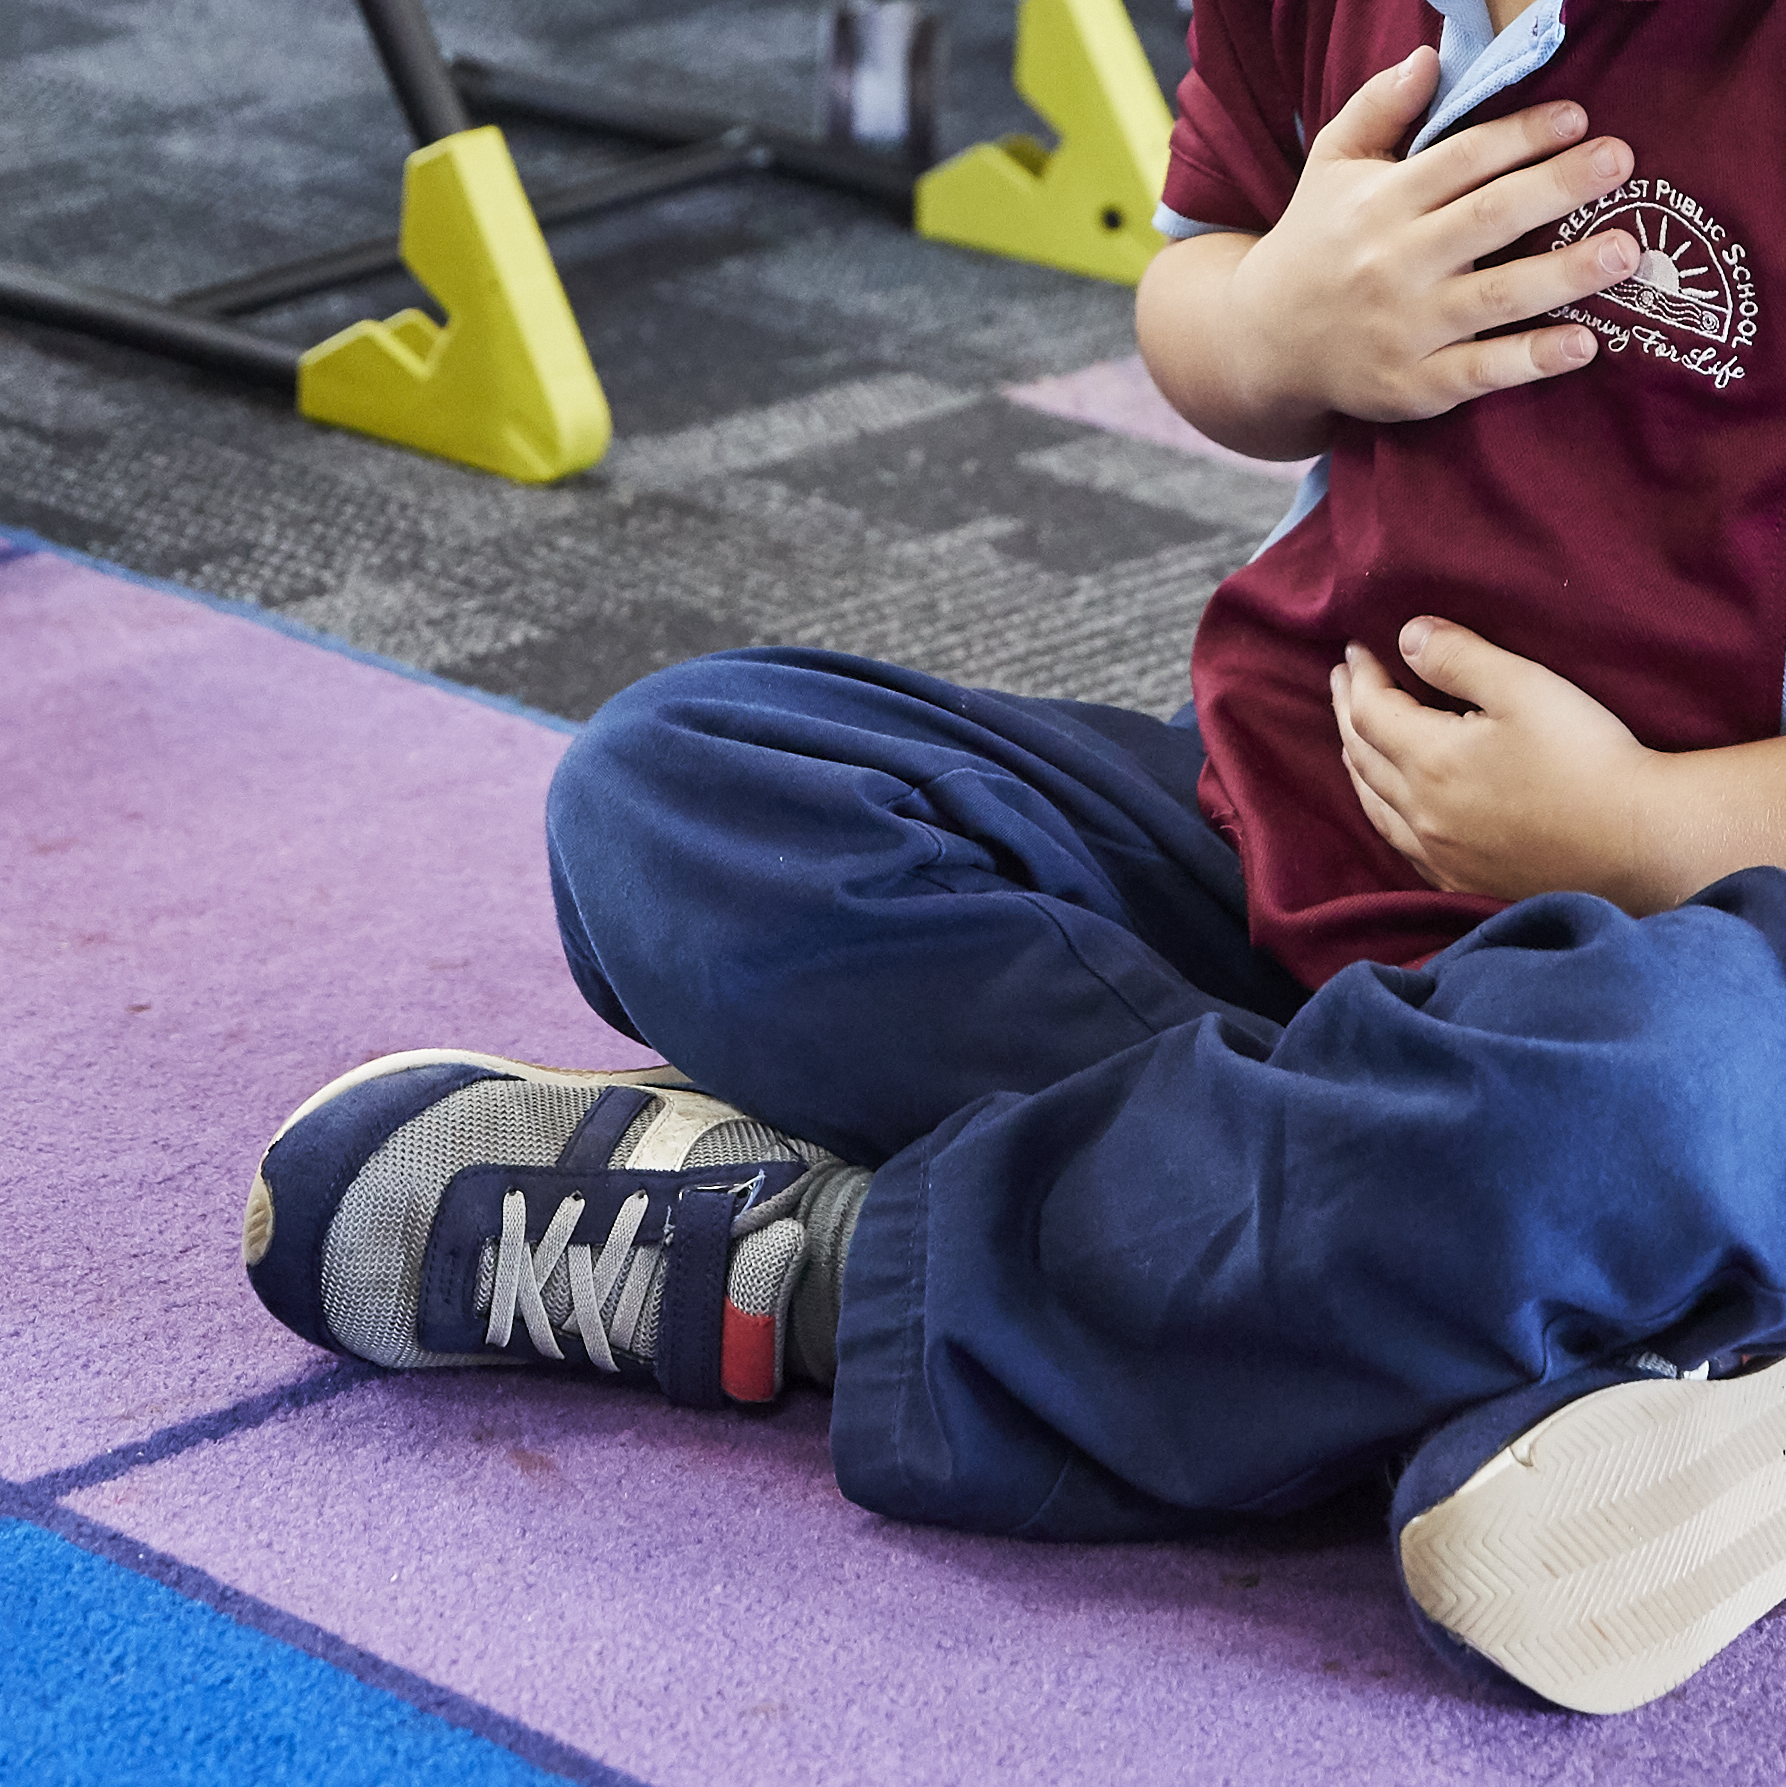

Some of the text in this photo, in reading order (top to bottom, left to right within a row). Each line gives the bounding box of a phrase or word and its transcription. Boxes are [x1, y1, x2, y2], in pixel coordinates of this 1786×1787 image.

[1598, 180, 1650, 209] EAST
[1656, 179, 1726, 242] PUBLIC
[1721, 243, 1759, 349] SCHOOL
[1632, 325, 1680, 363] For
[1681, 347, 1746, 389] Life
